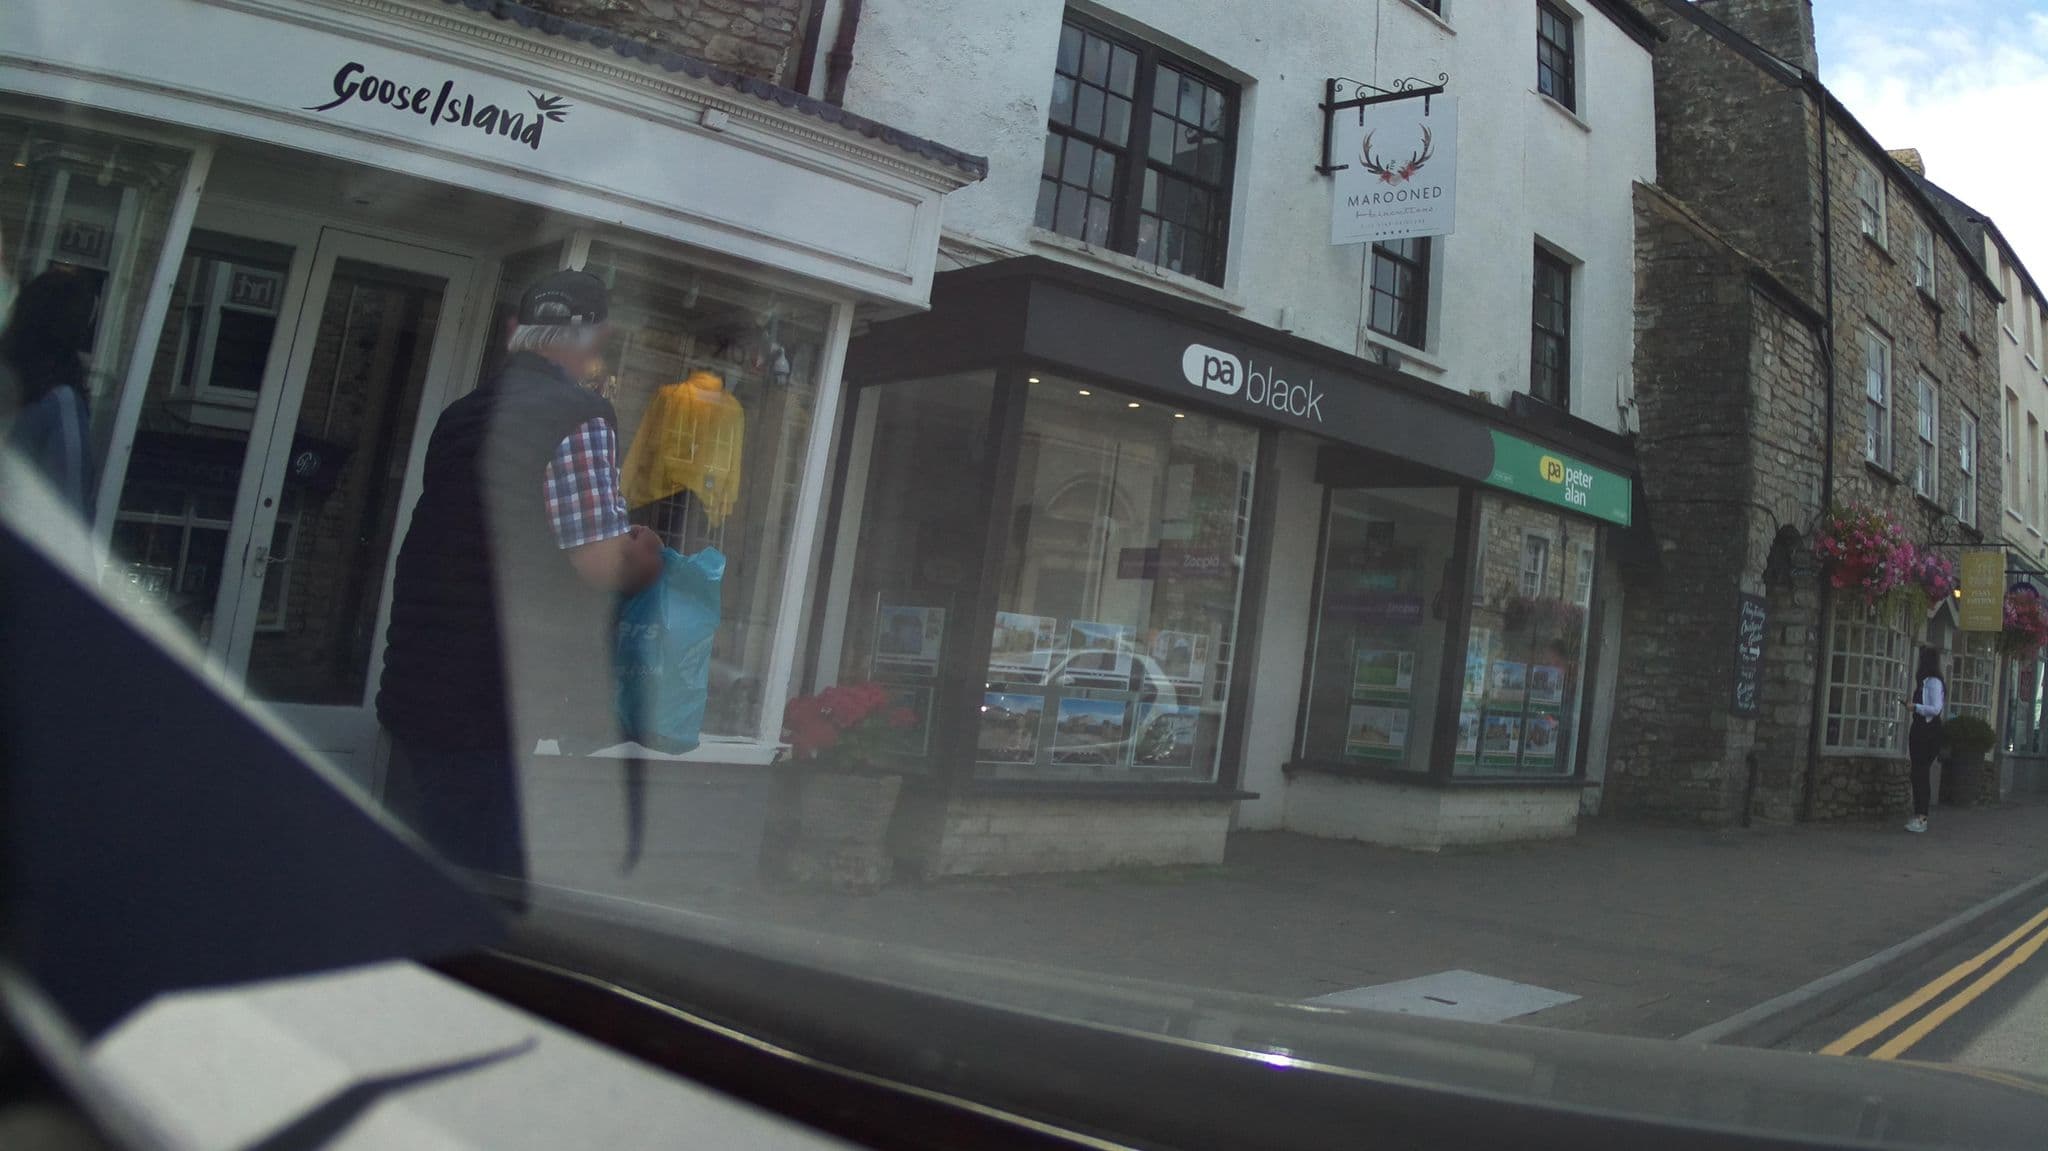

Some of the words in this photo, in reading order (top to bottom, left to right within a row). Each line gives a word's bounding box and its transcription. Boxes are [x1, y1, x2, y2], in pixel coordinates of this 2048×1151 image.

[1347, 186, 1442, 207] MAROONED
[1202, 354, 1235, 389] pa
[1246, 360, 1324, 424] black
[1547, 461, 1562, 480] pa
[1565, 467, 1593, 489] peter
[1564, 484, 1586, 507] alan
